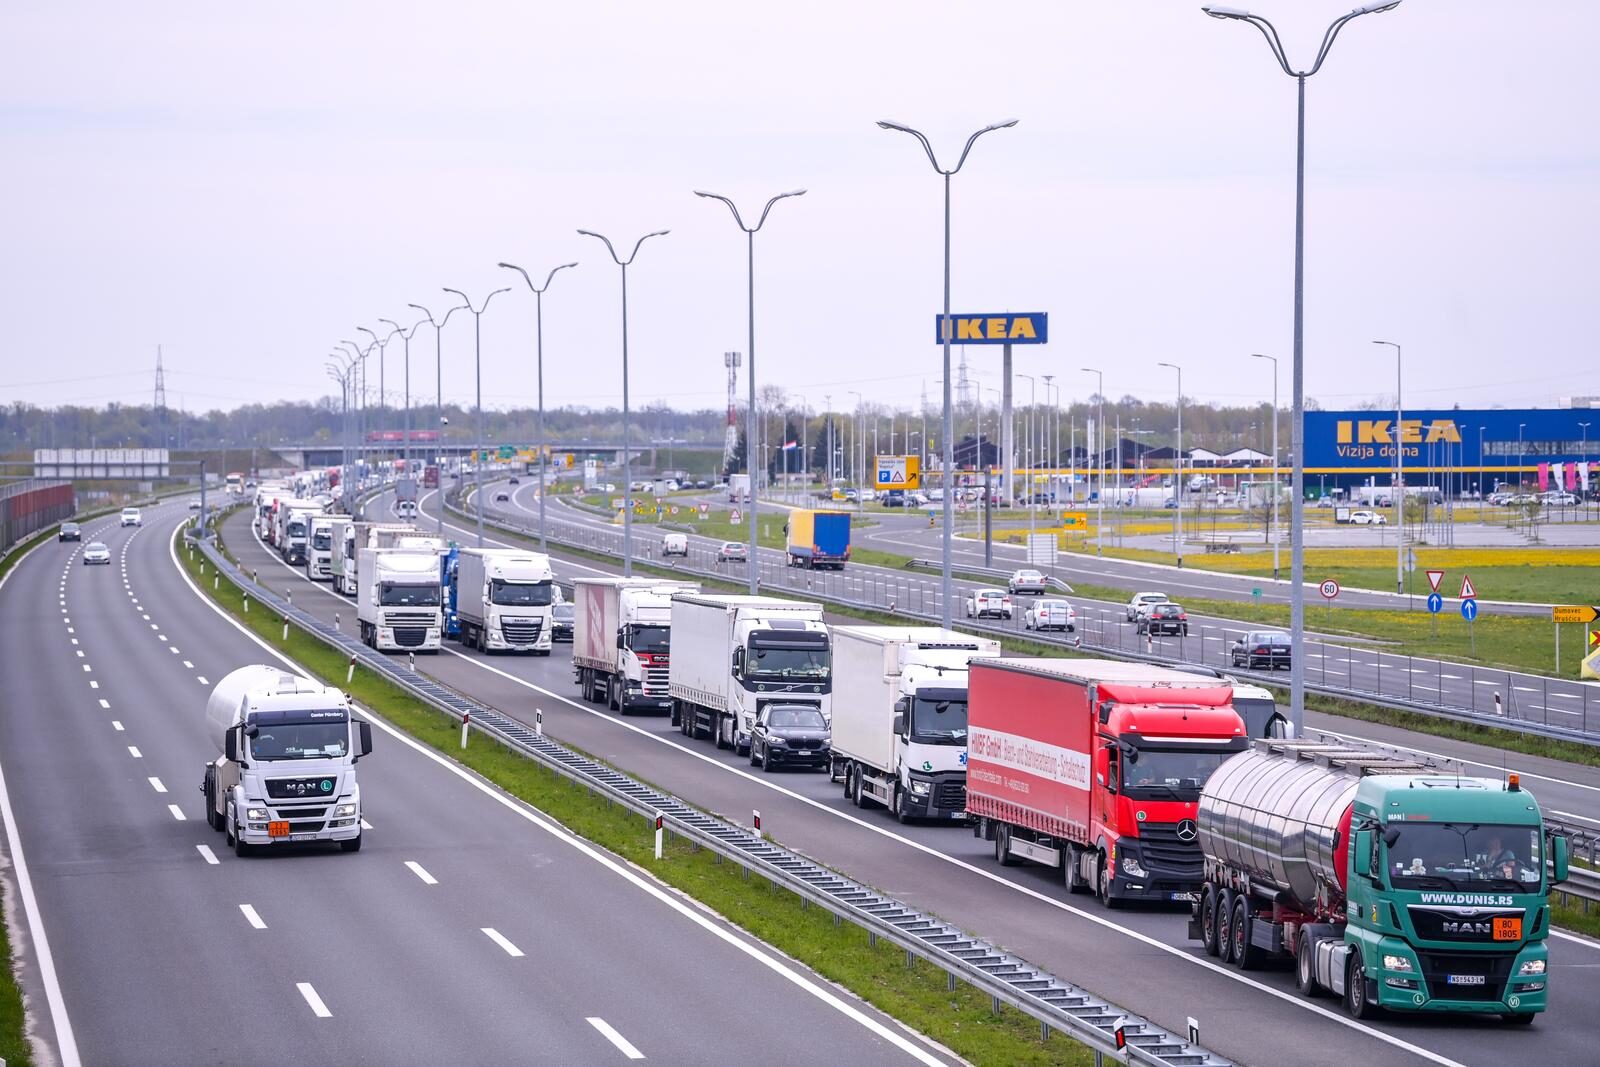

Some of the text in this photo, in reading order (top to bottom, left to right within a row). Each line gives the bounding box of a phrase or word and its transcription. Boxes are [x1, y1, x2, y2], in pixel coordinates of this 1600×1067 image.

[1336, 419, 1462, 443] IKEA
[1337, 445, 1375, 460] Vizija
[1324, 585, 1335, 594] 60
[286, 782, 316, 790] MAN
[1420, 893, 1513, 906] WWW.DUNIS.RS
[1442, 921, 1491, 933] MAN
[1502, 920, 1512, 928] 80
[1498, 930, 1518, 938] 1805
